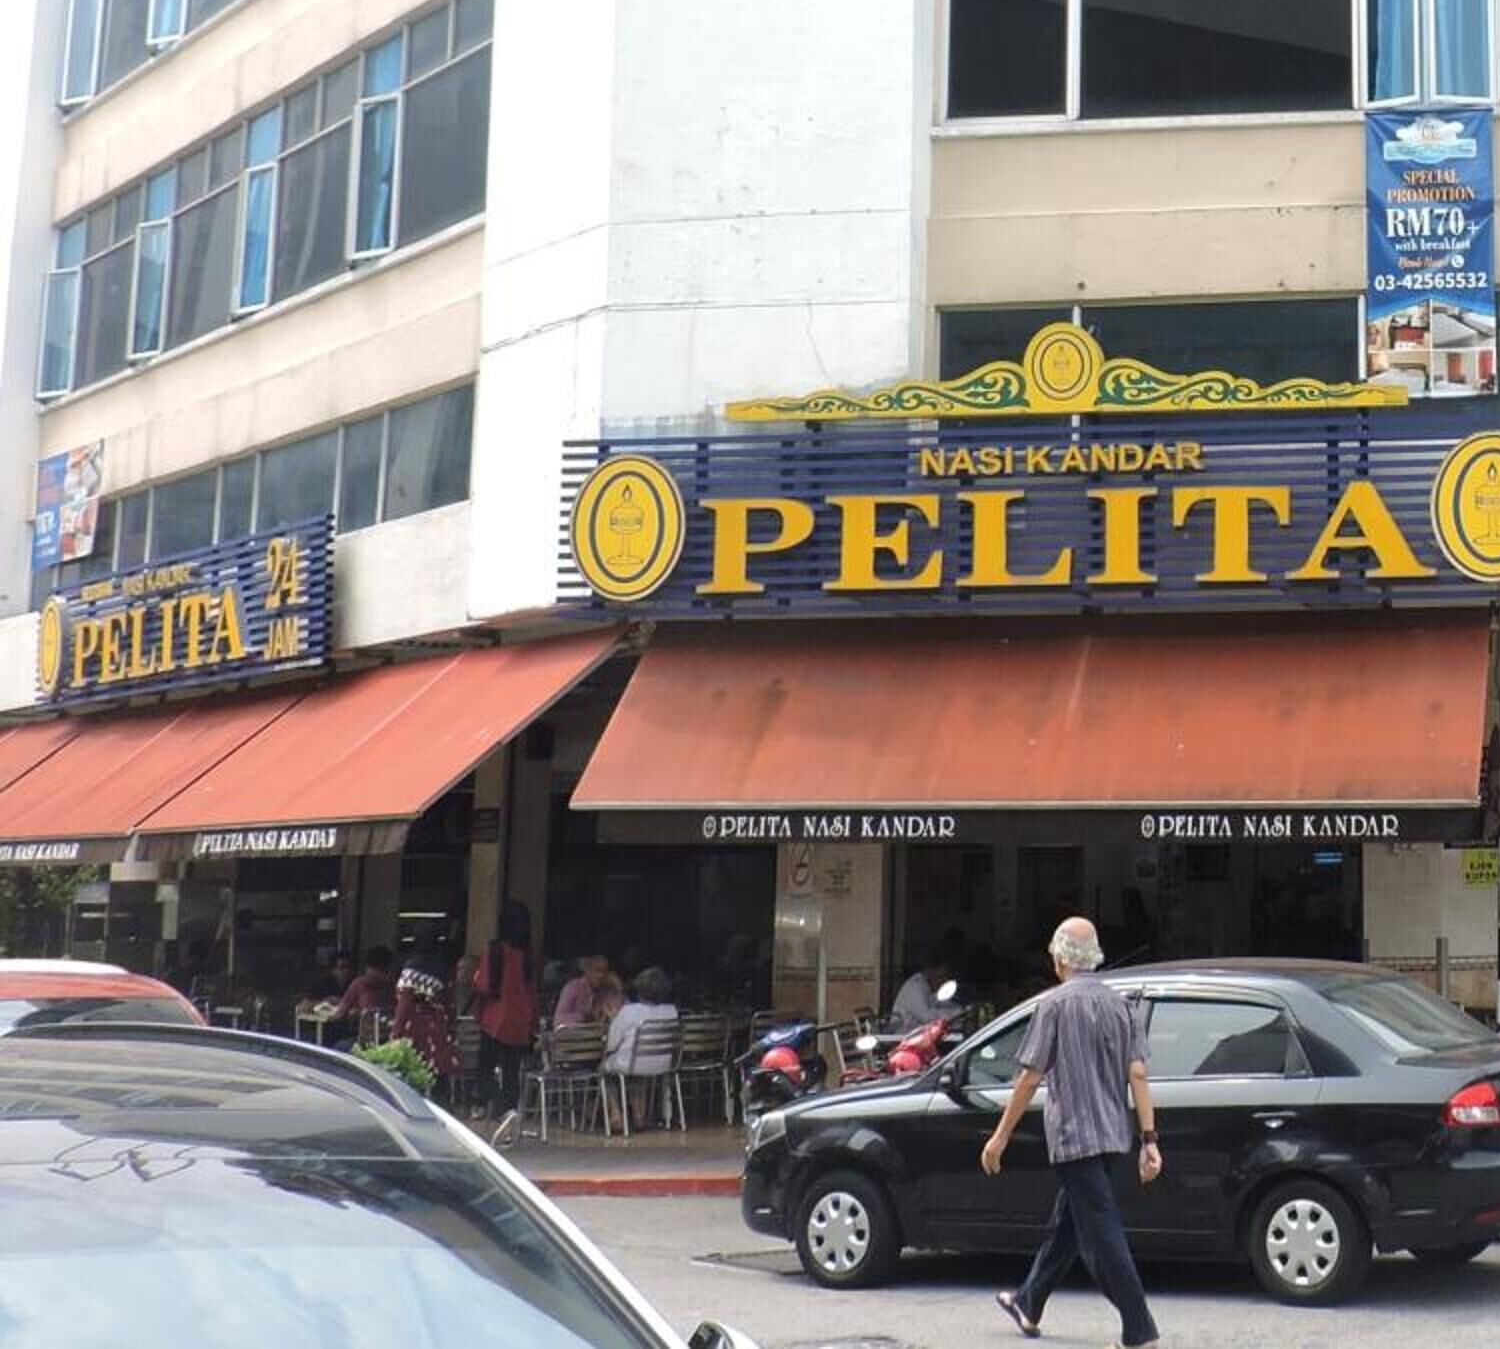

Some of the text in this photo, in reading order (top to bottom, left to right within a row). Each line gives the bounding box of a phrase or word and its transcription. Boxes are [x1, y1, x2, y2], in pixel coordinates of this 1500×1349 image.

[1402, 169, 1460, 186] SPECIAL
[1386, 186, 1476, 204] PROMOTION
[1395, 237, 1471, 251] with breakfast
[1374, 272, 1488, 291] 03-42565532
[918, 440, 1204, 477] NASI KANDAR
[694, 479, 1440, 596] PELITA
[266, 537, 301, 609] 24
[70, 585, 246, 688] PELITA
[263, 617, 300, 660] JAM
[719, 816, 956, 839] PELITA NASI KANDAR
[1158, 814, 1399, 838] PELITA NASI KANDAR
[200, 827, 338, 854] PELITA NASI KANDAR
